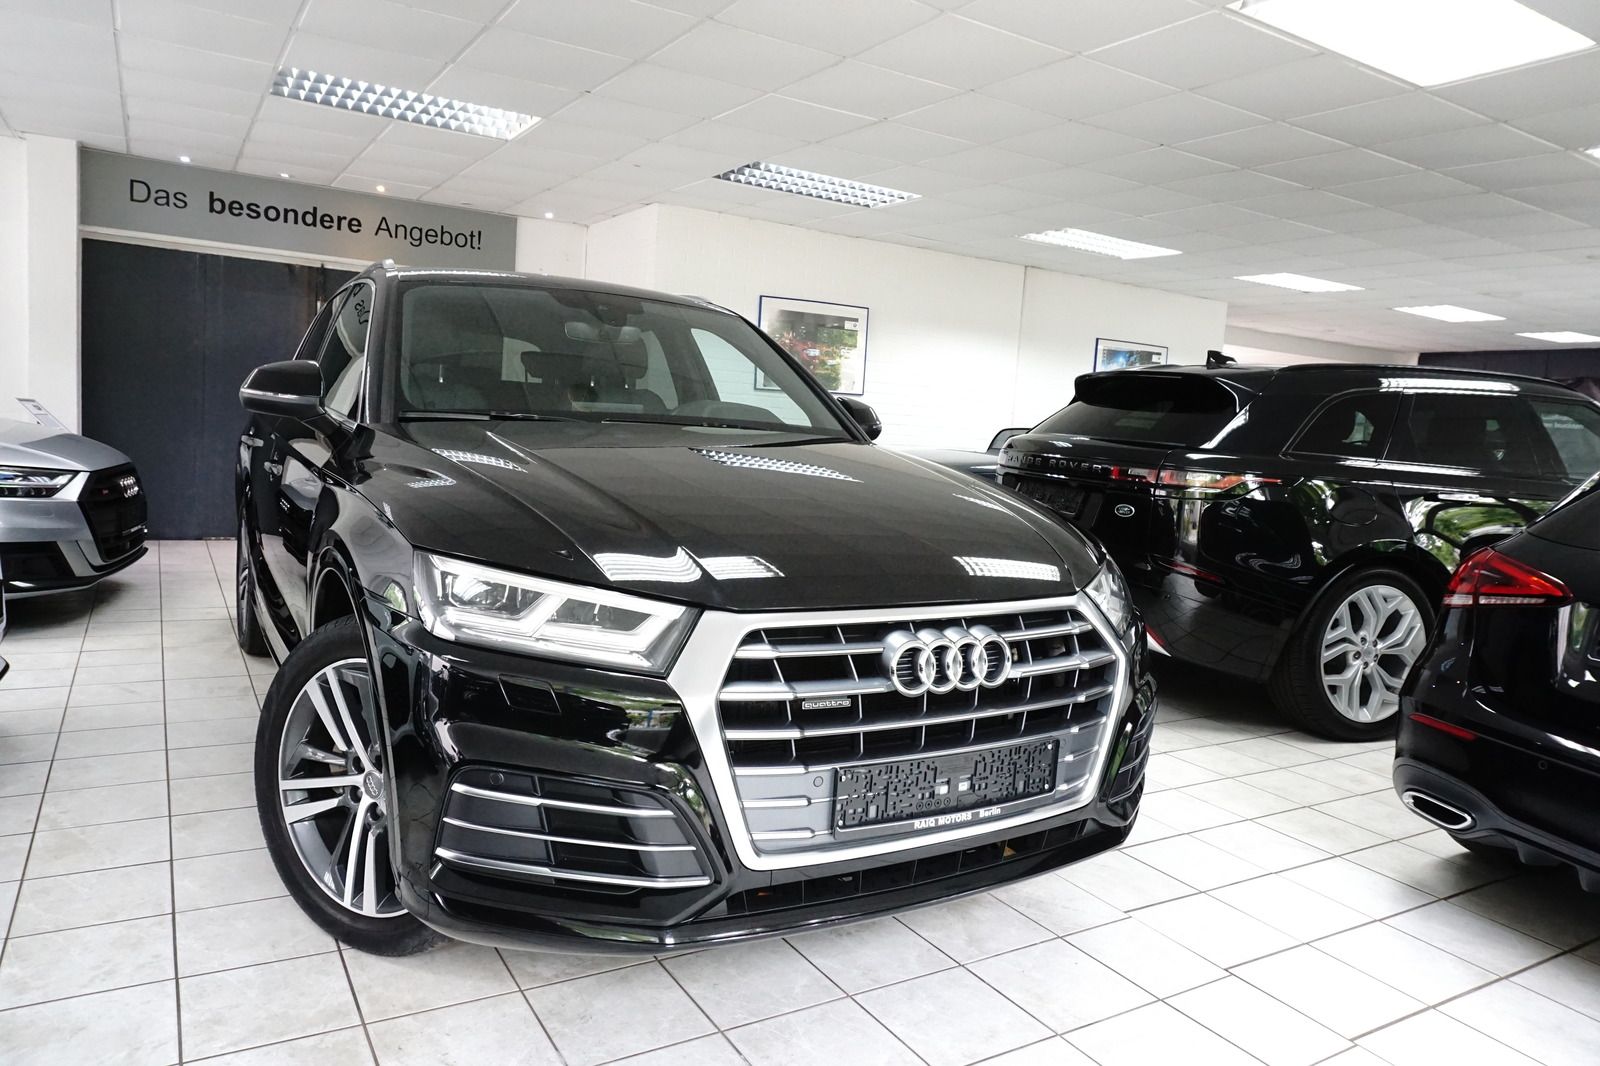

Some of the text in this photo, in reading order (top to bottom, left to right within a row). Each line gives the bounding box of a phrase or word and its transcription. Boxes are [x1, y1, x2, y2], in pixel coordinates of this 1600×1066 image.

[129, 179, 482, 250] Das besondere Angebot!
[1049, 459, 1102, 473] ROVER
[804, 700, 850, 709] quattro
[938, 812, 972, 826] MOTORS
[979, 807, 1001, 818] Berlin
